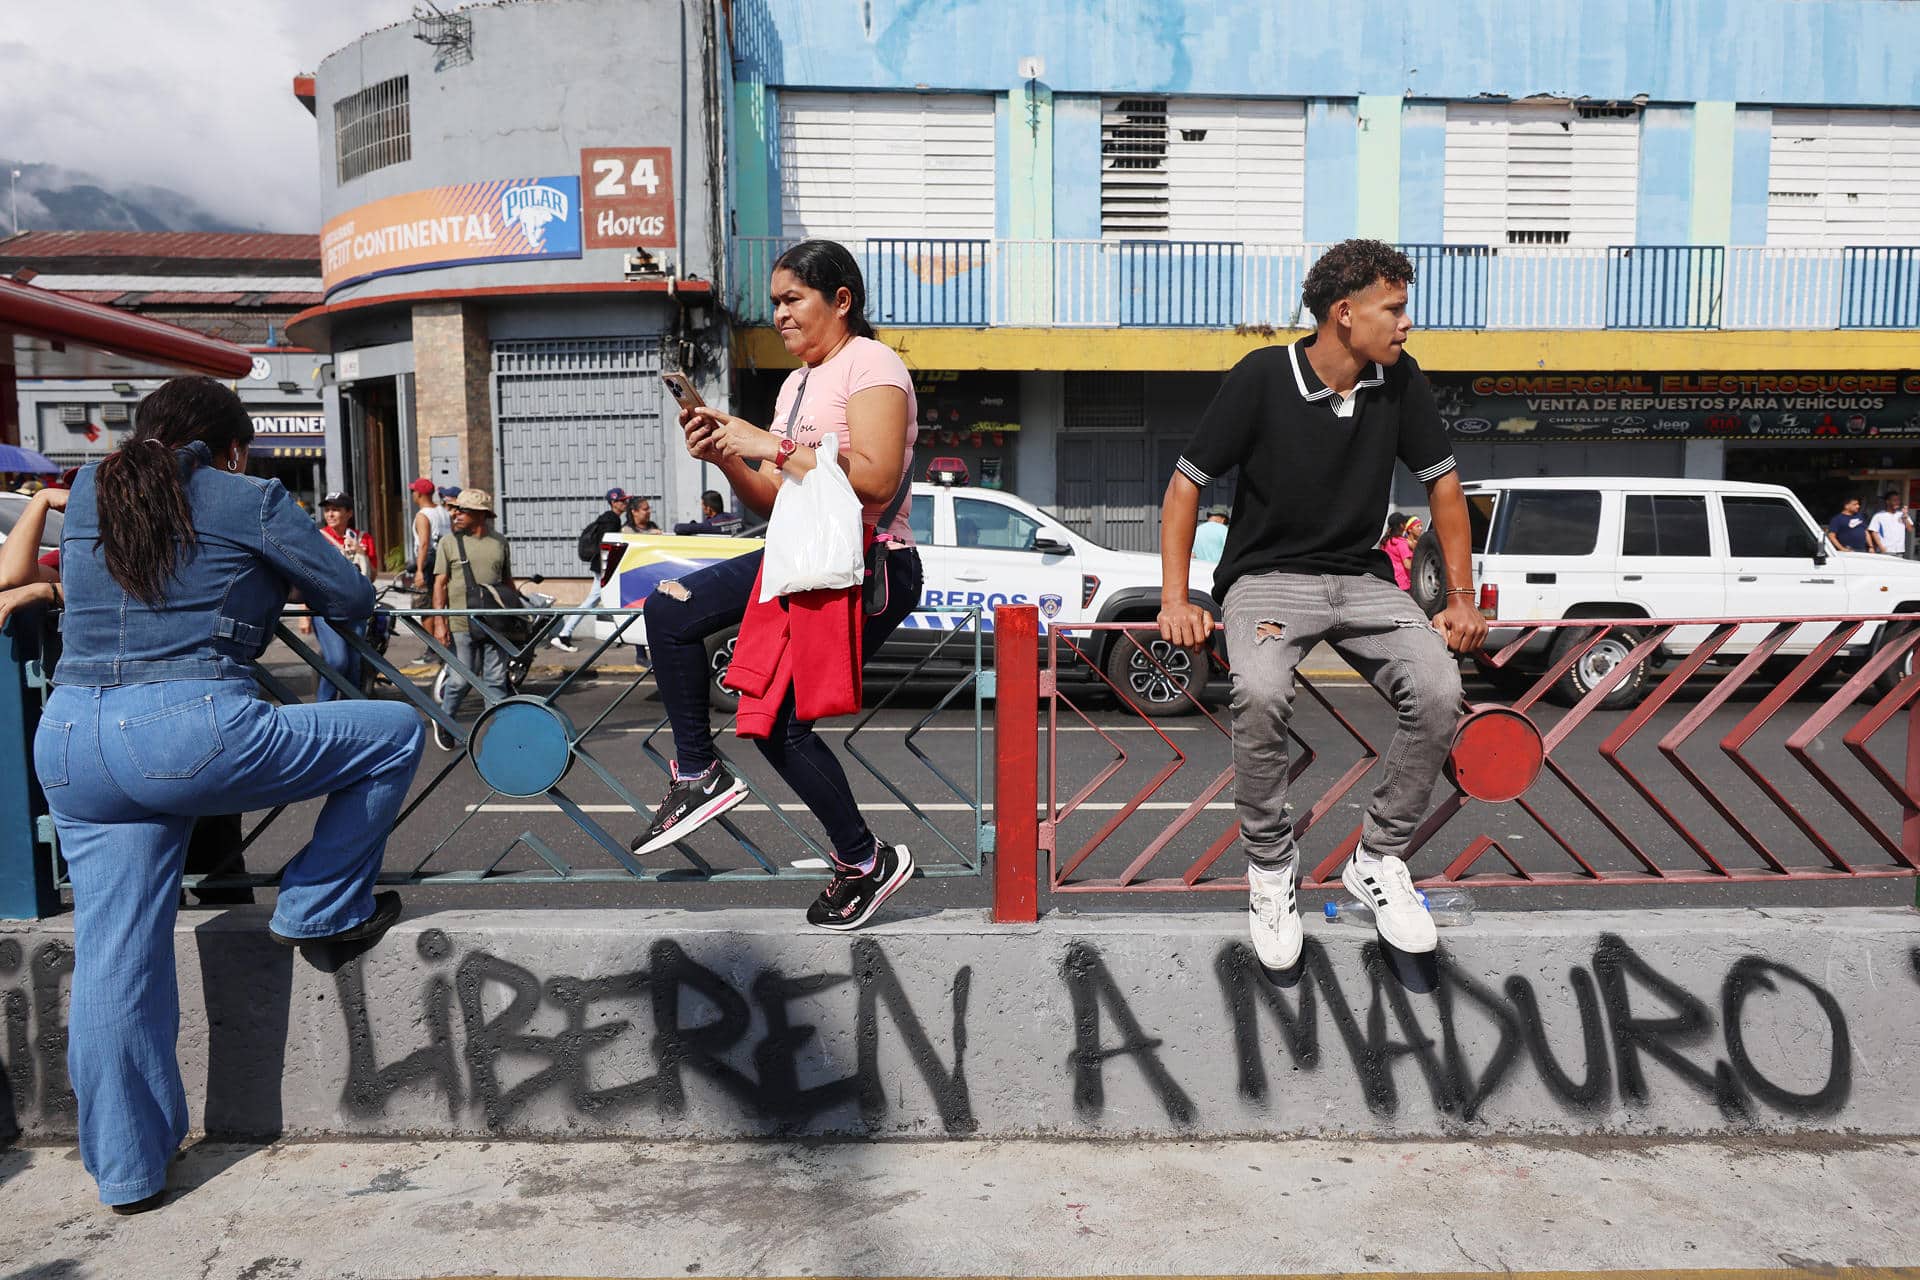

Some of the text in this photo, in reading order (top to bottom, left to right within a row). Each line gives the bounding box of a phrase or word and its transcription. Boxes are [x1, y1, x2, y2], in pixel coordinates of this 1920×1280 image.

[593, 159, 659, 196] 24
[506, 187, 564, 218] POLAR
[354, 213, 497, 260] CONTINENTAL
[597, 210, 664, 237] Horas
[1472, 376, 1654, 395] COMERCIAL
[1660, 376, 1897, 394] ELECTROSUCRE
[1527, 395, 1884, 411] VENTA DE REPUESTOS PARA VEHÍCULOS
[1652, 418, 1690, 433] Jeep
[918, 590, 1028, 613] BEROS
[1060, 943, 1199, 1128] A
[1214, 933, 1852, 1125] MADURO
